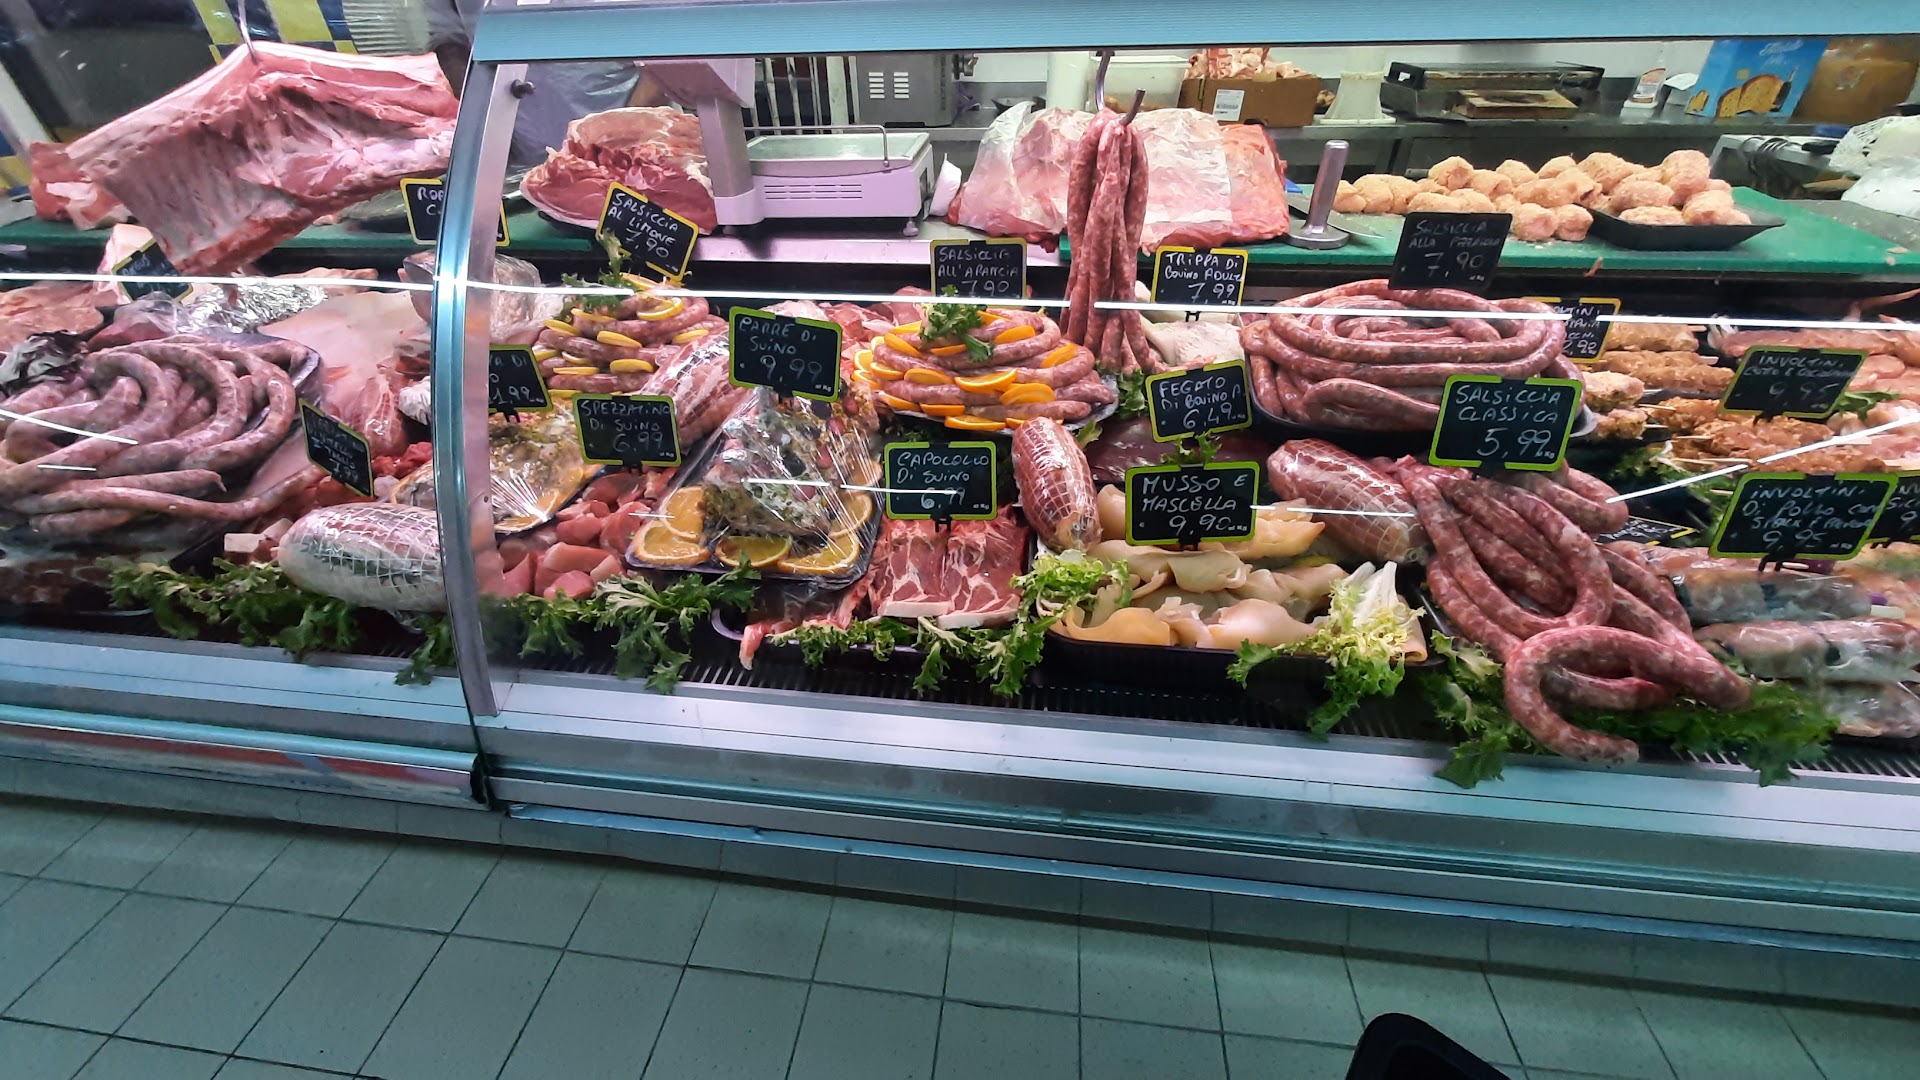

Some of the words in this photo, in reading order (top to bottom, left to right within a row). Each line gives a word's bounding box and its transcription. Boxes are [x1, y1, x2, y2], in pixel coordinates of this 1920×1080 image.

[612, 193, 679, 231] SALSICCIA
[608, 207, 622, 220] AL
[629, 217, 676, 246] LIMONE
[1165, 252, 1219, 267] TRIPPA
[1225, 255, 1239, 270] DI
[1164, 265, 1199, 279] BOVINO
[1554, 303, 1600, 316] OLTINI
[750, 336, 796, 354] SUINO
[801, 330, 816, 342] DI
[760, 355, 822, 382] 9,99
[1159, 376, 1226, 398] FEGATO
[1455, 384, 1561, 405] SALSICCIA
[1161, 397, 1179, 410] DI
[1185, 392, 1228, 410] BOVINO
[590, 418, 604, 430] DI
[615, 419, 660, 432] SUINO
[1183, 402, 1232, 429] 6,49
[1458, 406, 1558, 424] CLASSICA
[614, 432, 663, 453] 6,99
[1477, 427, 1552, 458] 5,99
[897, 467, 913, 484] DI
[923, 470, 970, 484] SUINO
[1142, 475, 1220, 494] MUSSO
[1233, 474, 1248, 487] E
[1142, 496, 1237, 513] MASCELLA
[1772, 500, 1834, 521] POLLO
[1168, 514, 1231, 536] 9,90
